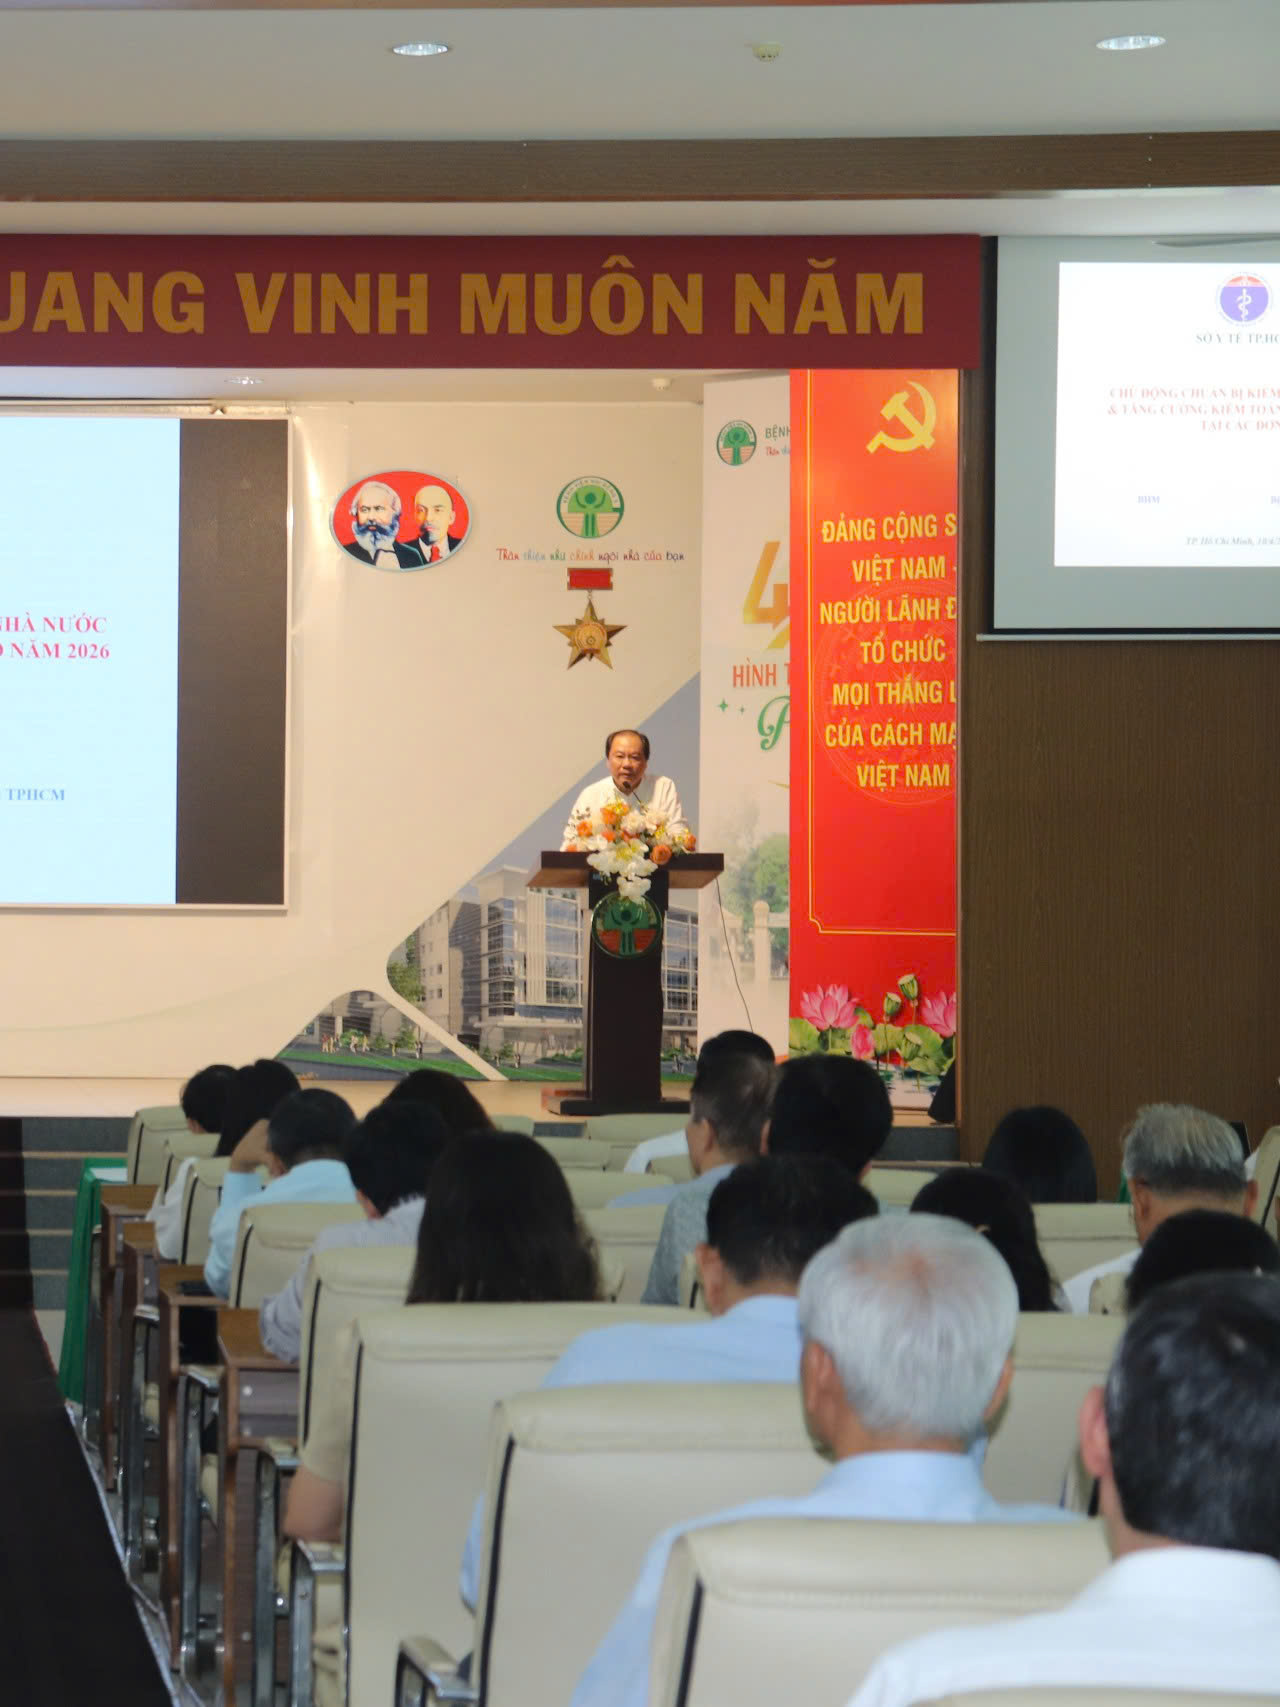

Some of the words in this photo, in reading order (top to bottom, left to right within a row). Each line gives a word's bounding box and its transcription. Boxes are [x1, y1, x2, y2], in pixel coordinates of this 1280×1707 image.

[235, 272, 428, 334] VINH
[460, 254, 703, 335] MUÔN
[734, 257, 923, 335] NĂM
[821, 512, 876, 543] ĐẢNG
[882, 511, 938, 544] CỘNG
[852, 553, 895, 586] VIỆT
[901, 556, 946, 580] NAM
[42, 612, 107, 633] NƯỚC
[820, 595, 881, 625] NGƯỜI
[887, 594, 940, 622] LÃNH
[10, 639, 60, 659] NĂM
[67, 642, 110, 659] 2026
[891, 633, 946, 664] CHỨC
[733, 657, 777, 688] HÌNH
[832, 682, 869, 710] MỌI
[875, 673, 943, 705] THẮNG
[825, 717, 865, 747] CỦA
[870, 718, 922, 747] CÁCH
[856, 759, 899, 792] VIỆT
[905, 763, 950, 787] NAM
[7, 788, 65, 801] TPHCM
